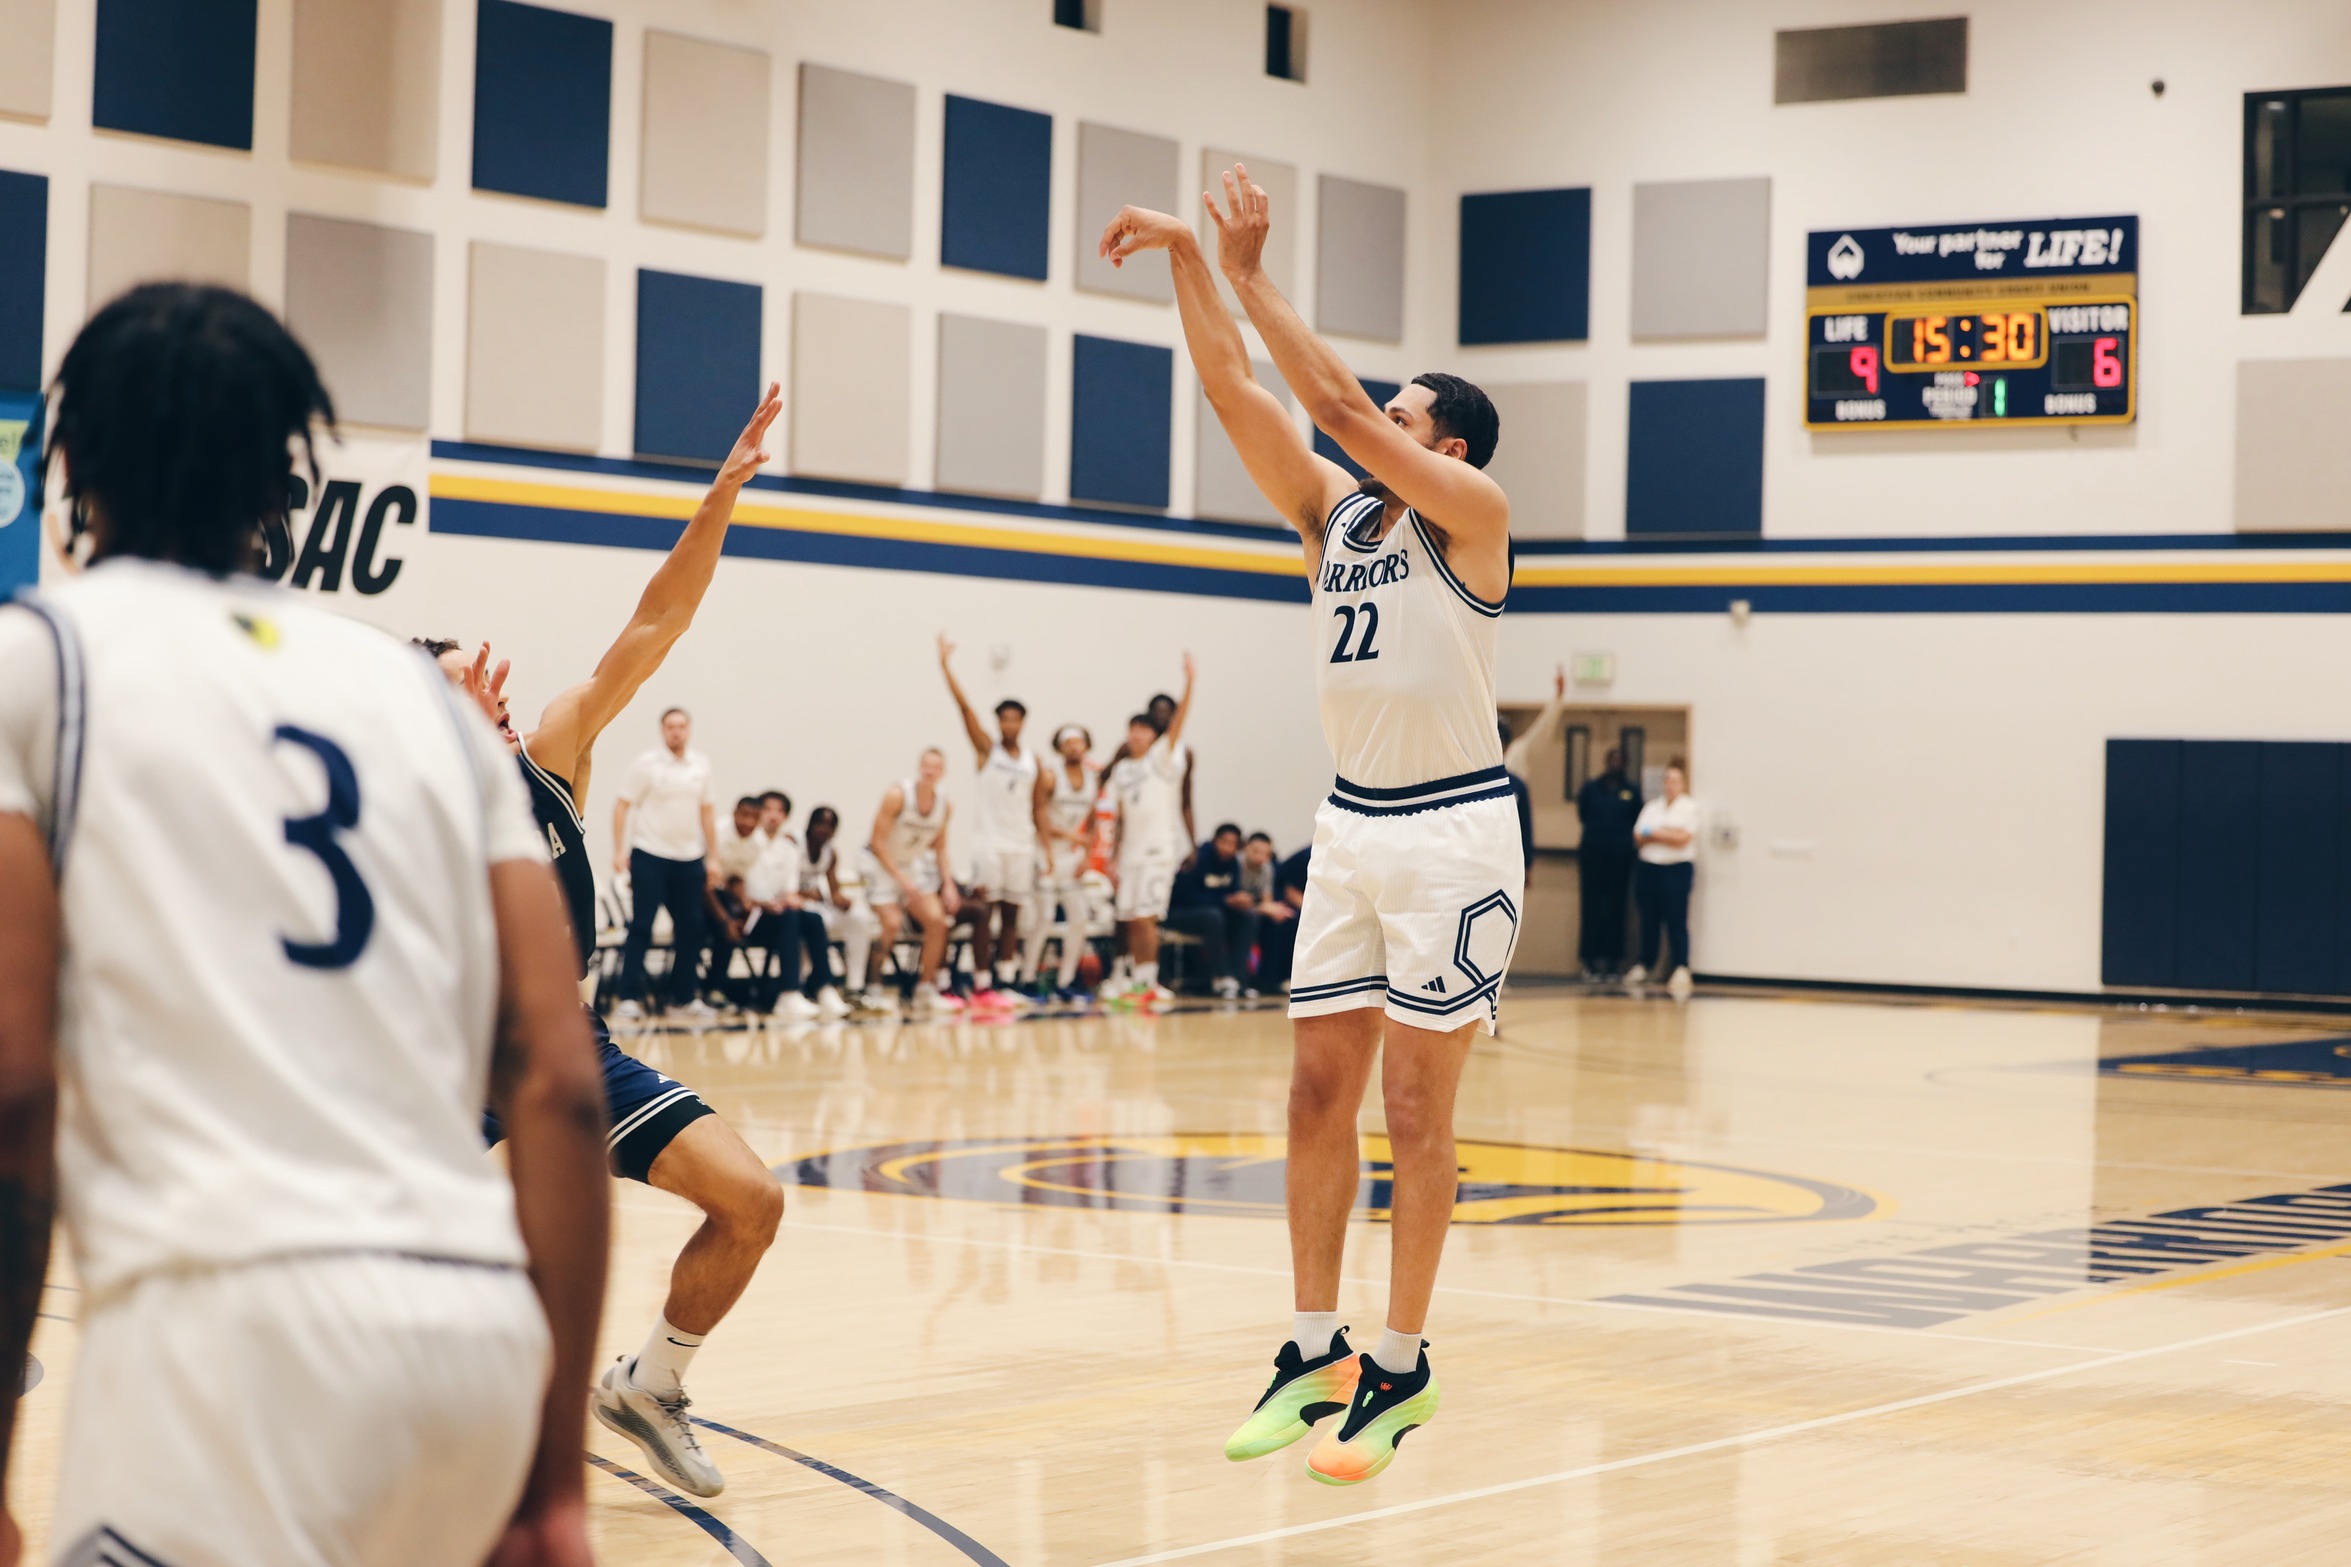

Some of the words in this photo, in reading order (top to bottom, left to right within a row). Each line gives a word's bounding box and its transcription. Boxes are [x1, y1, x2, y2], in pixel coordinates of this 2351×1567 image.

[1893, 232, 1937, 255] Your
[1938, 228, 2024, 257] partner
[1974, 251, 2006, 270] for
[2023, 228, 2123, 268] LIFE!
[1824, 315, 1868, 342] LIFE
[2048, 305, 2128, 333] VISITOR
[1913, 313, 2035, 364] 15:30
[1850, 346, 1878, 394] 9
[2093, 337, 2122, 387] 6
[1835, 399, 1886, 421] BONUS
[1994, 378, 2005, 416] 1
[2044, 392, 2097, 415] BONUS
[1330, 602, 1379, 663] 22
[271, 725, 374, 968] 3
